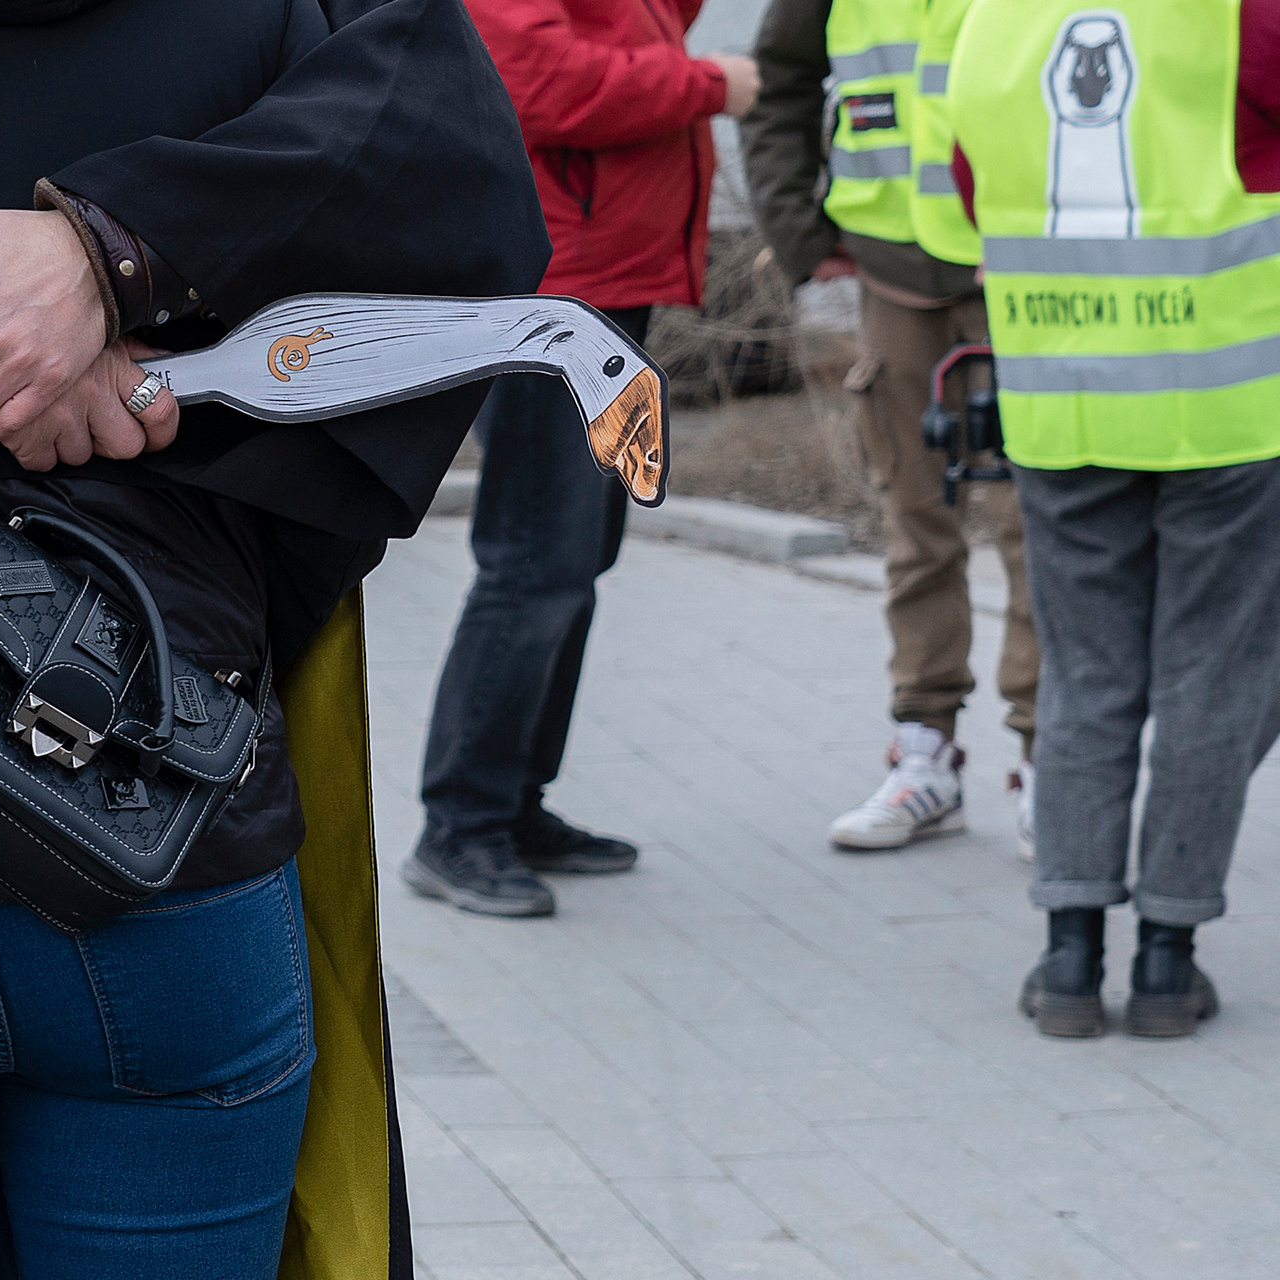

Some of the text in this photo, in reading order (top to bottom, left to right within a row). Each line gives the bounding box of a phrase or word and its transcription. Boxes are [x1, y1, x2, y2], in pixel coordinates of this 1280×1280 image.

[1005, 284, 1195, 326] Я ОТПУСТИЛ ГУСЕЙ
